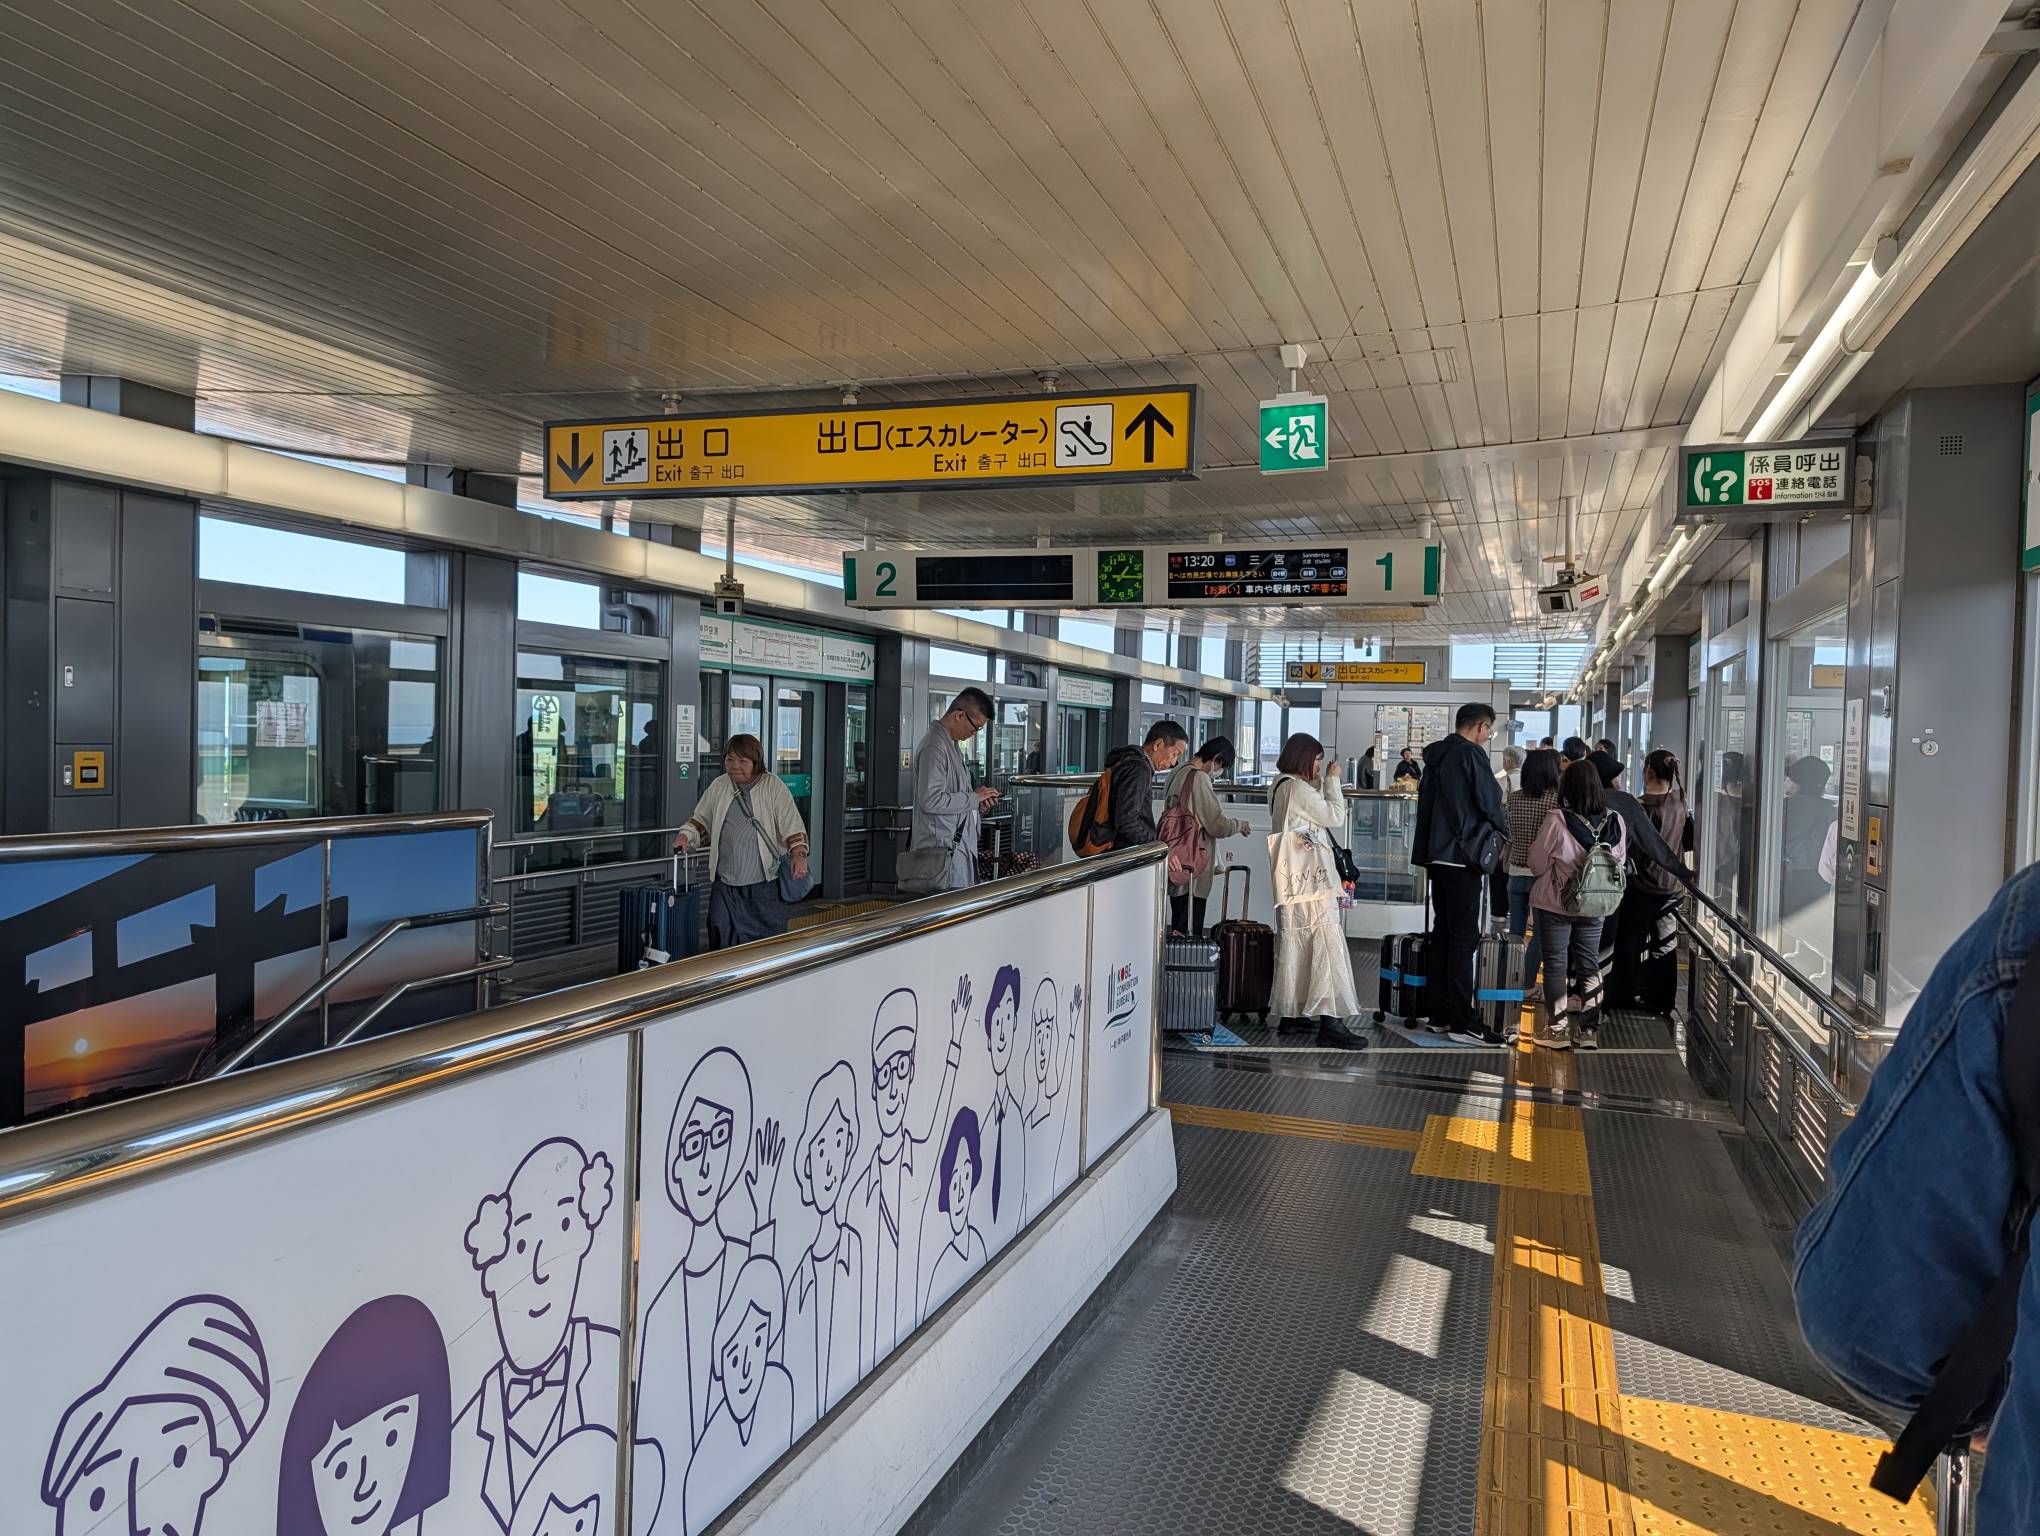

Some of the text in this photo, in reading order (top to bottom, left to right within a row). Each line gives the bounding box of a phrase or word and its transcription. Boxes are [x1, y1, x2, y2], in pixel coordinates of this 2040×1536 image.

[656, 427, 729, 460] 出口
[818, 417, 1049, 454] 出口(エスカレーター)
[656, 464, 745, 482] Exit 출구 出口
[934, 452, 1046, 473] Exit 출구 出口
[1749, 452, 1841, 474] 係員呼出
[1775, 476, 1837, 490] 連絡電話
[1775, 491, 1813, 500] Information
[1184, 555, 1215, 567] 13:20
[1375, 552, 1393, 591] 1
[875, 562, 897, 596] 2
[860, 651, 867, 671] 2
